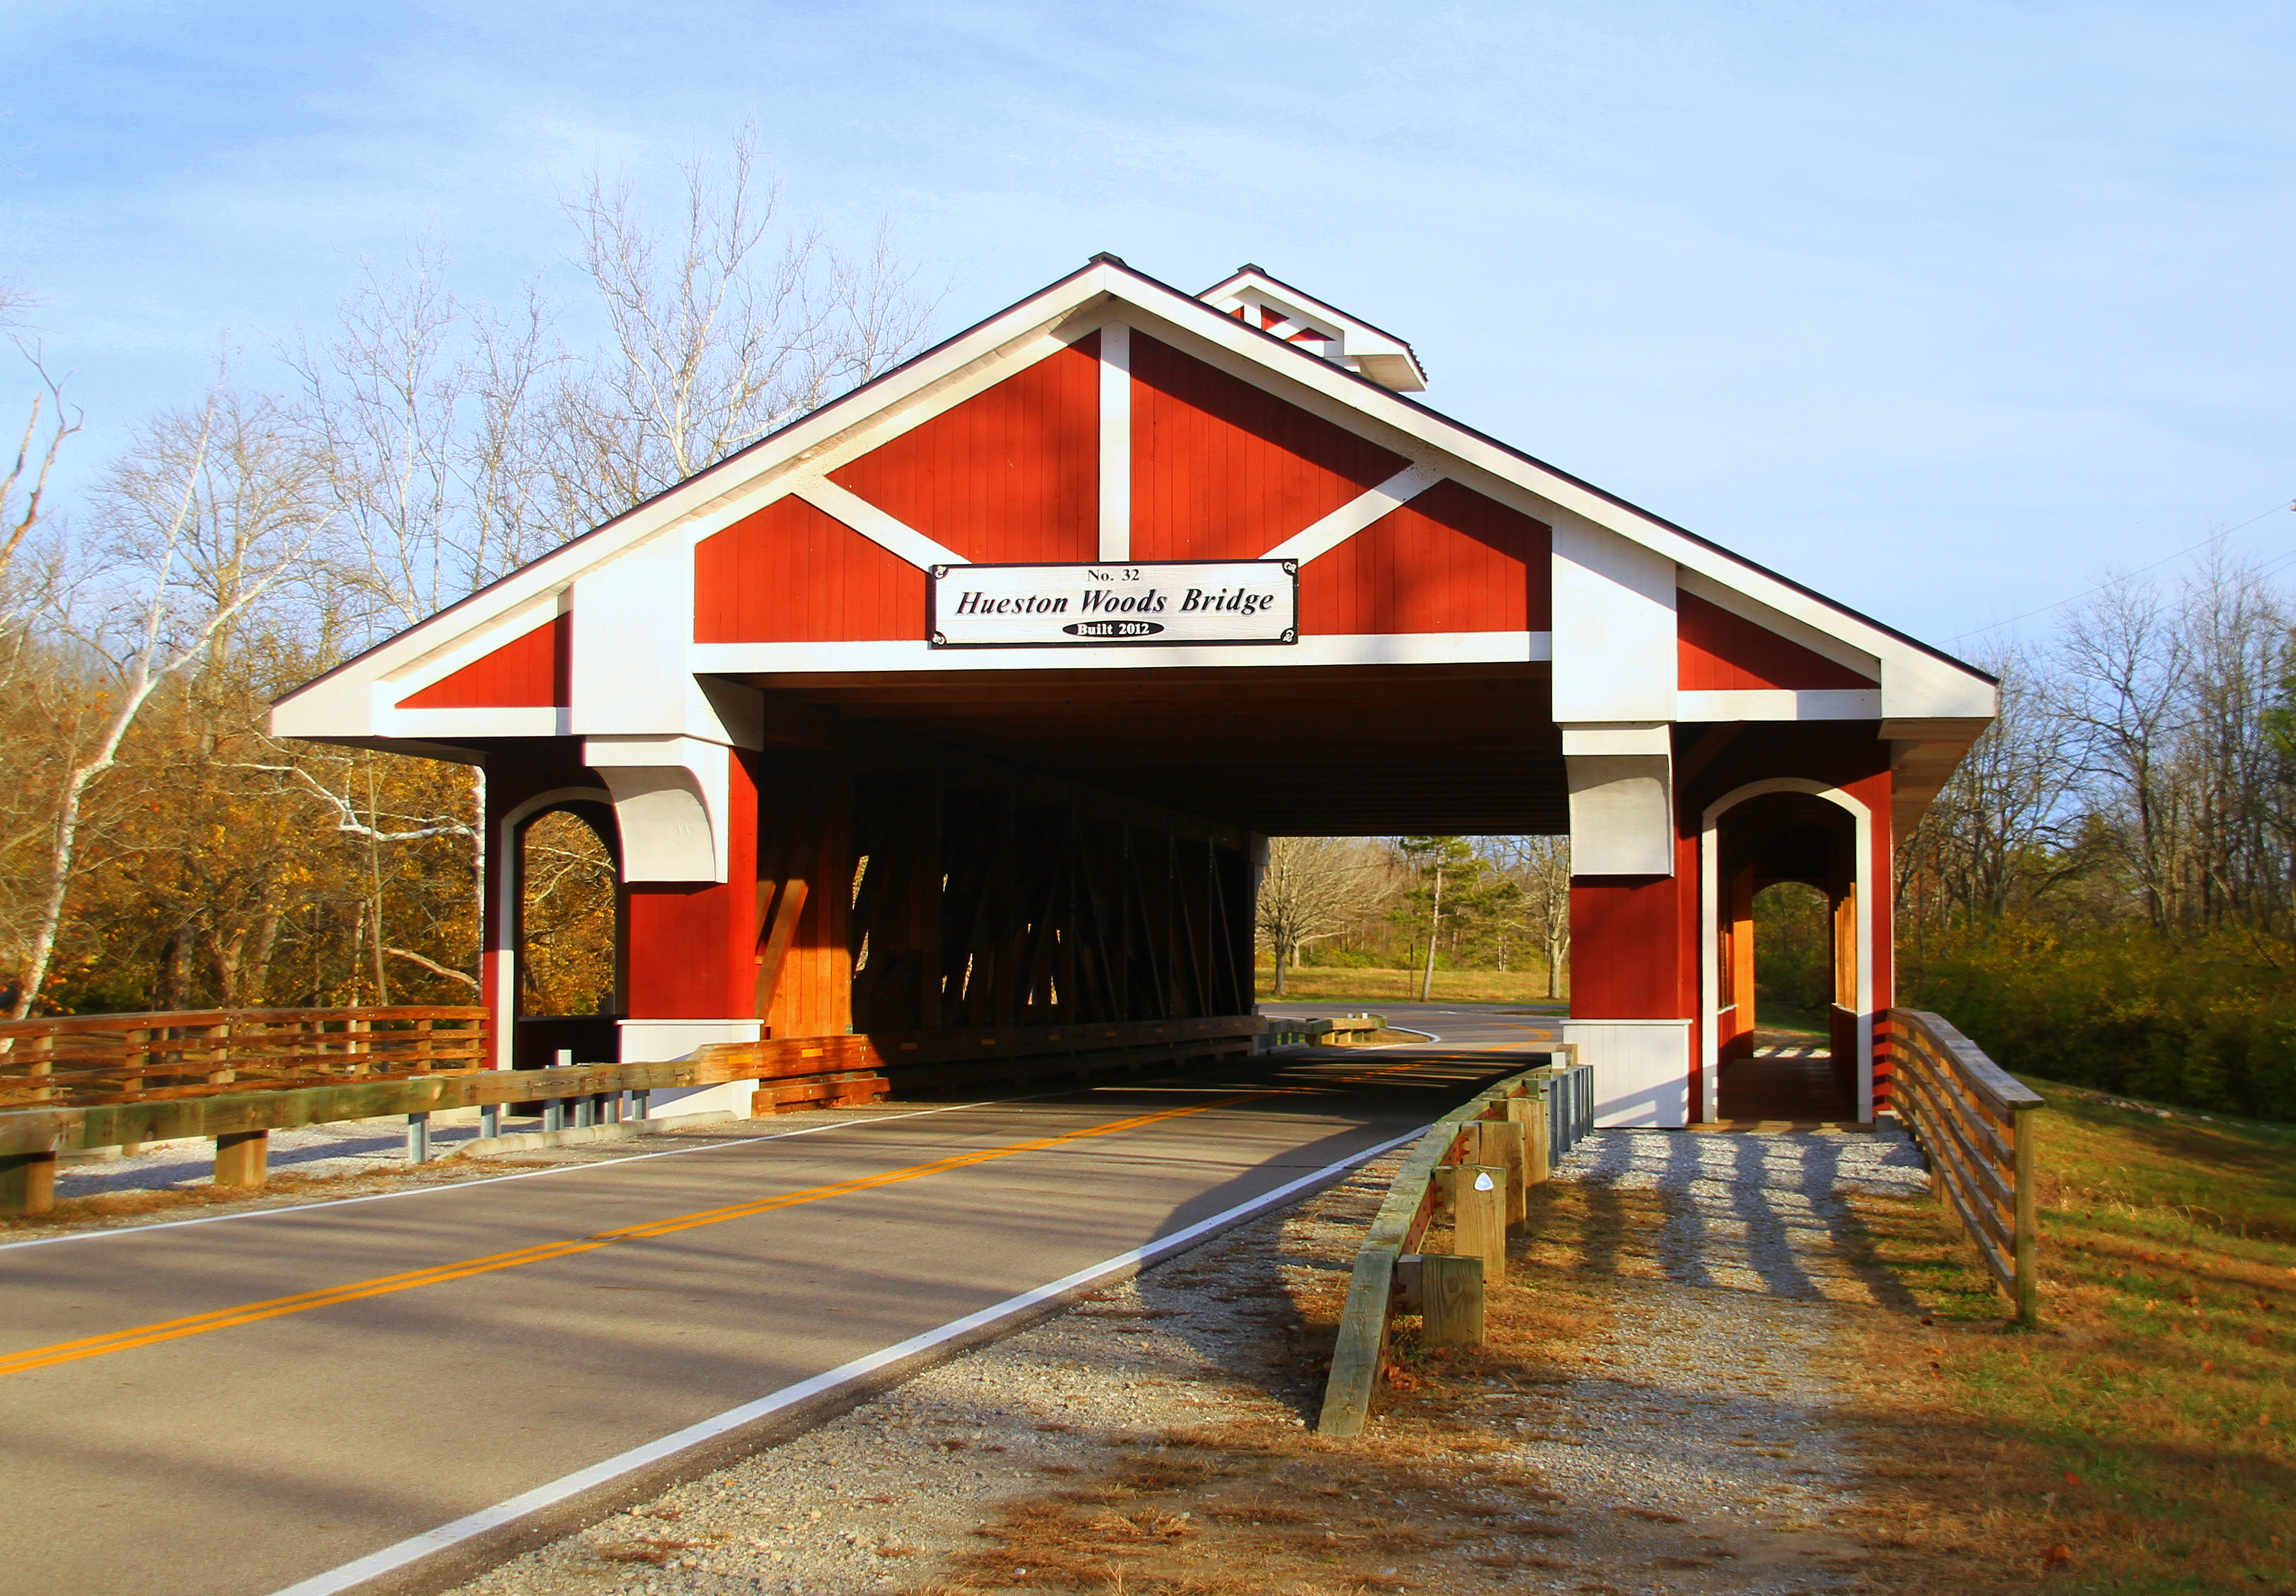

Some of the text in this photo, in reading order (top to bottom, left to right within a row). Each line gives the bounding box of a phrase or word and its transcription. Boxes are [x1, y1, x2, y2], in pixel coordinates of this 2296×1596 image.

[1087, 569, 1140, 582] No. 32
[955, 588, 1275, 616] Hueston Woods Bridge
[1077, 623, 1150, 635] Built 2012
